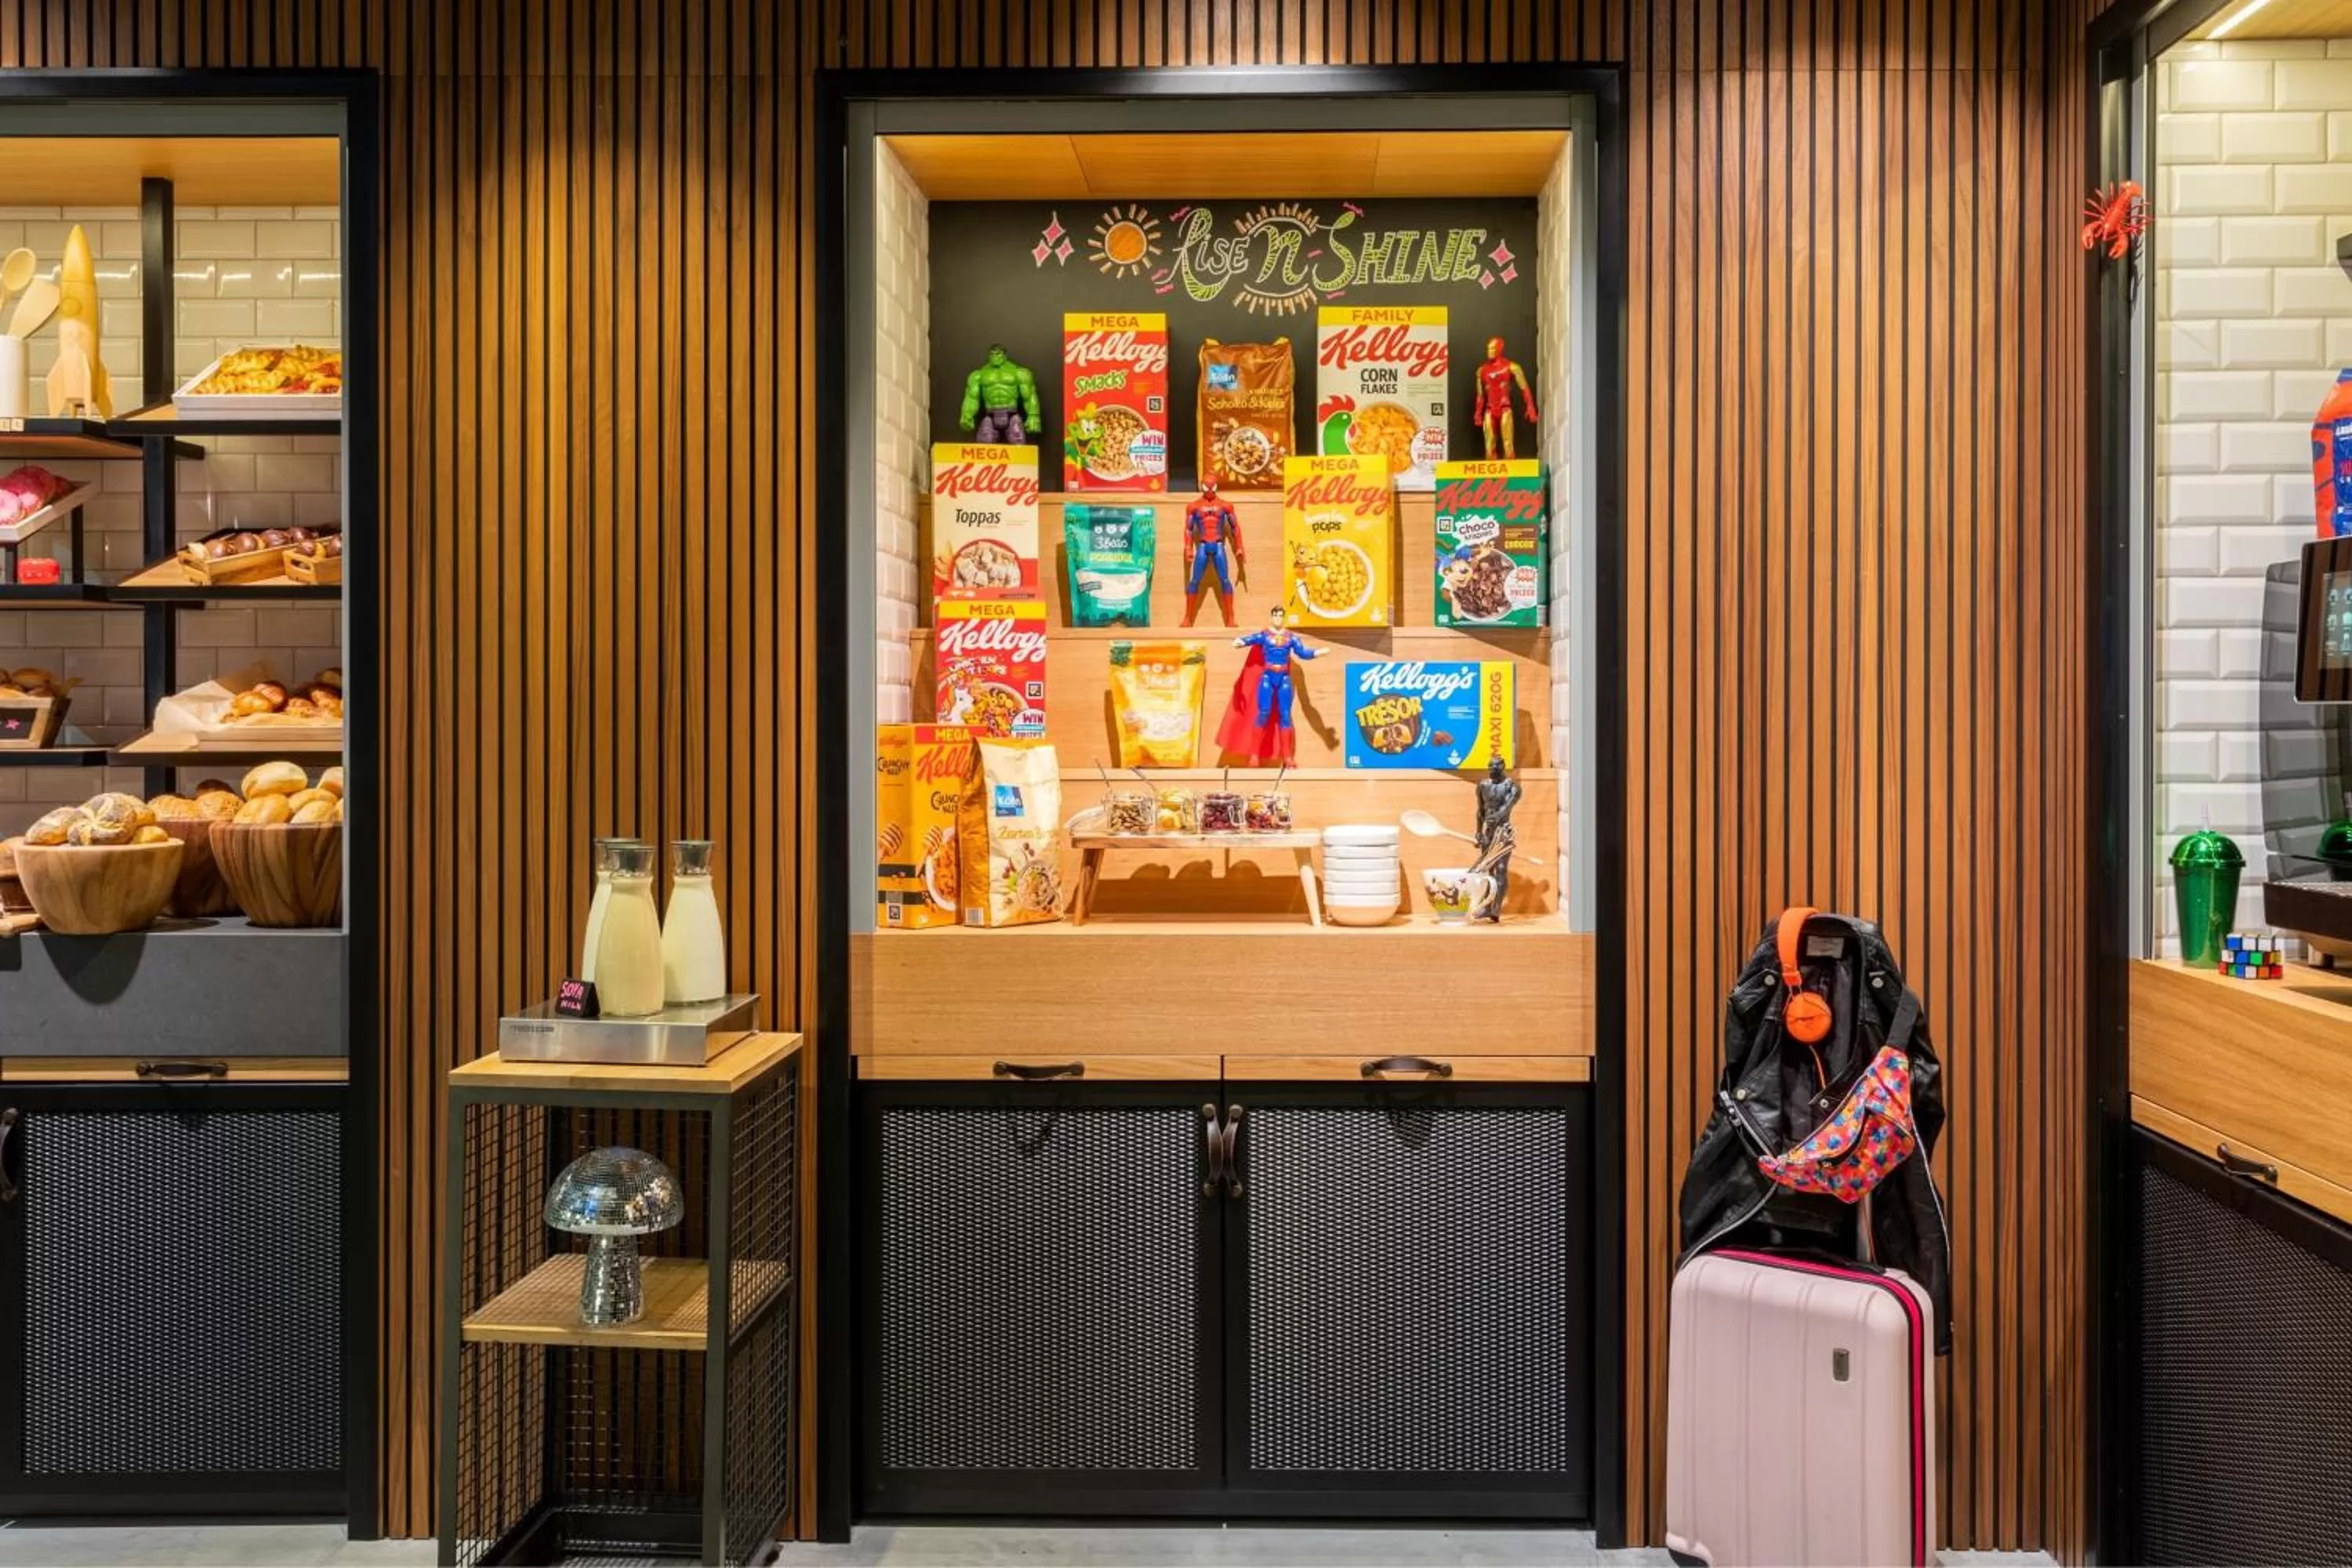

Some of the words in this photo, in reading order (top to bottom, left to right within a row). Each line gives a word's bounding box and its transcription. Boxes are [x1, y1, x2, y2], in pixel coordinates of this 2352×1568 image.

[1091, 316, 1139, 327] MEGA
[1352, 310, 1414, 321] FAMILY
[1360, 368, 1398, 383] CORN
[1360, 383, 1398, 394] FLAKES
[1142, 434, 1164, 445] WIN
[961, 448, 1010, 460] MEGA
[1310, 459, 1359, 470] MEGA
[1464, 464, 1508, 474] MEGA
[956, 508, 1001, 528] Toppas
[969, 604, 1015, 616] MEGA
[1360, 662, 1477, 700] Kellogg's
[1490, 672, 1502, 713] 620G
[1023, 713, 1044, 724] WIN
[935, 728, 971, 742] MEGA
[1490, 717, 1502, 759] MAXI
[561, 981, 583, 1000] SOYA
